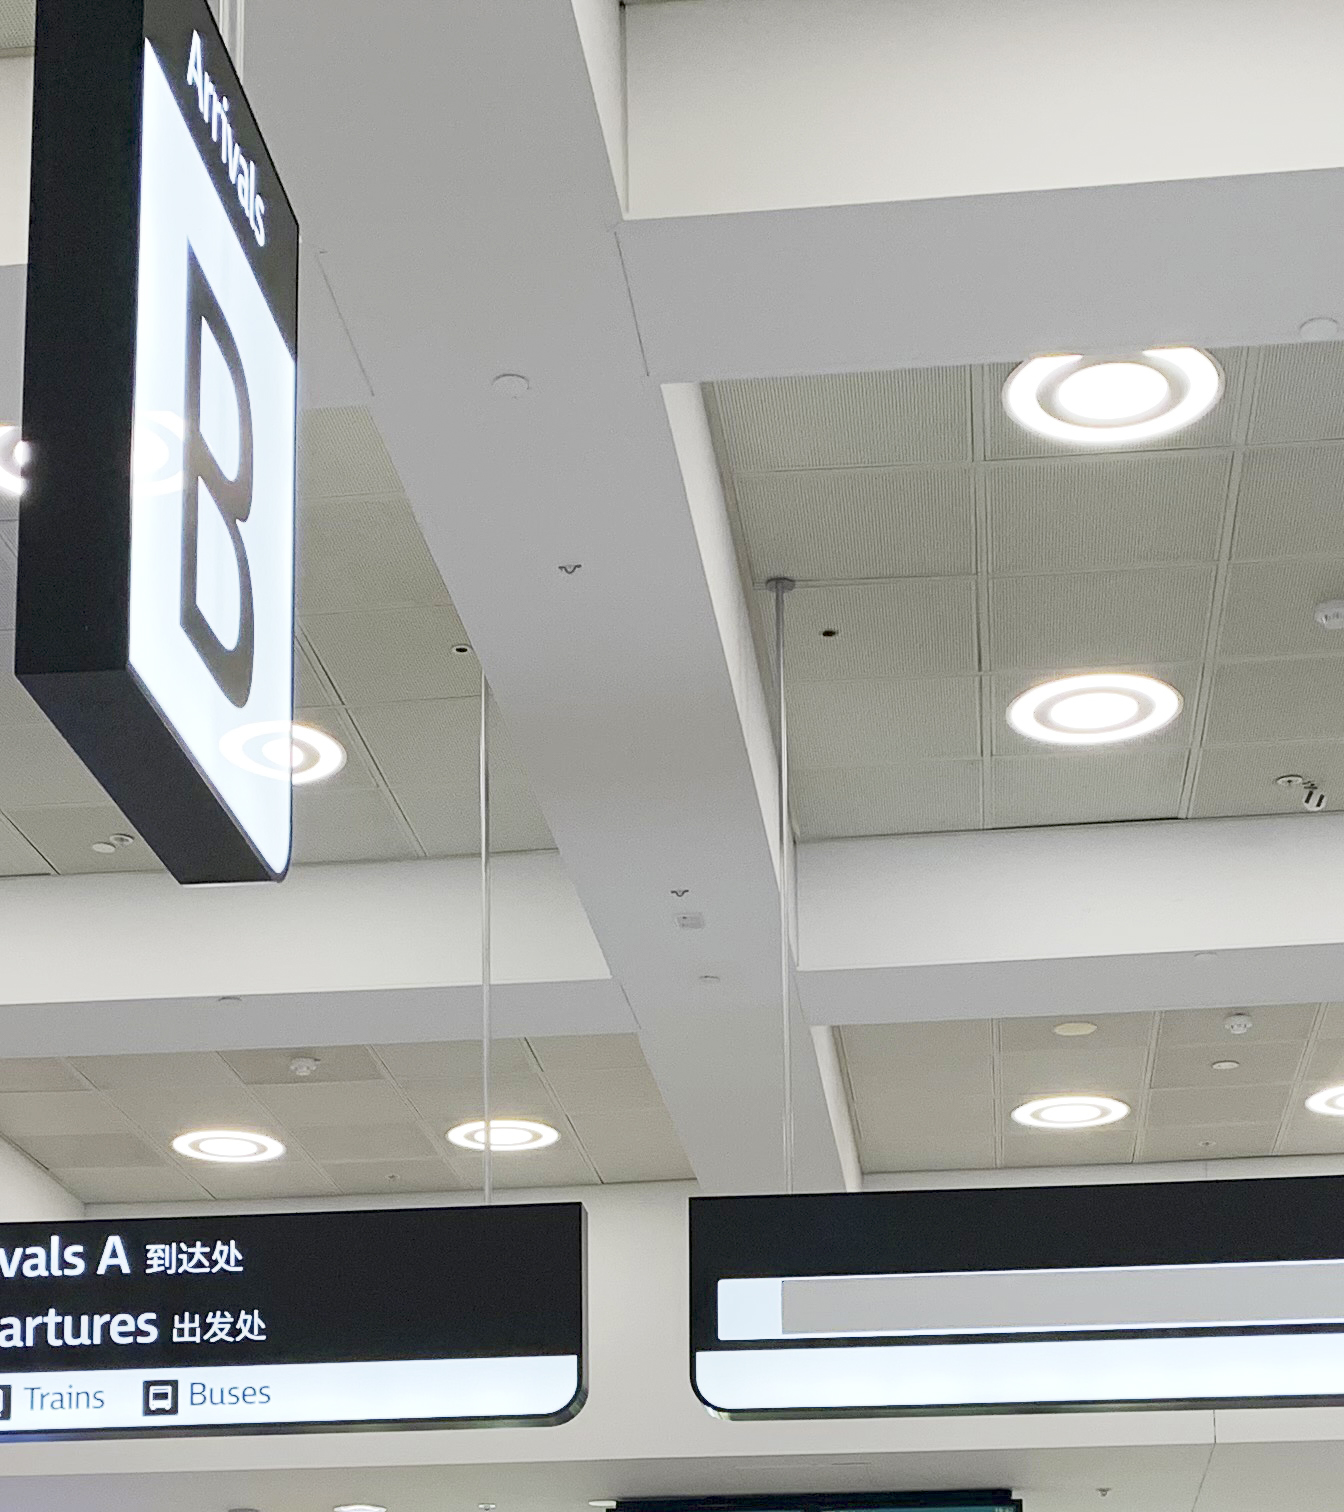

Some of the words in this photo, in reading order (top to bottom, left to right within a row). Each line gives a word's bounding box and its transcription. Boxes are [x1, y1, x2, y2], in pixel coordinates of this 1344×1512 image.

[187, 29, 266, 247] Arrivals
[179, 235, 255, 709] B
[96, 1235, 131, 1275] A
[145, 1240, 244, 1275] 到达处
[172, 1309, 267, 1344] 出发处
[24, 1385, 105, 1411] Trains
[190, 1382, 271, 1406] Buses
